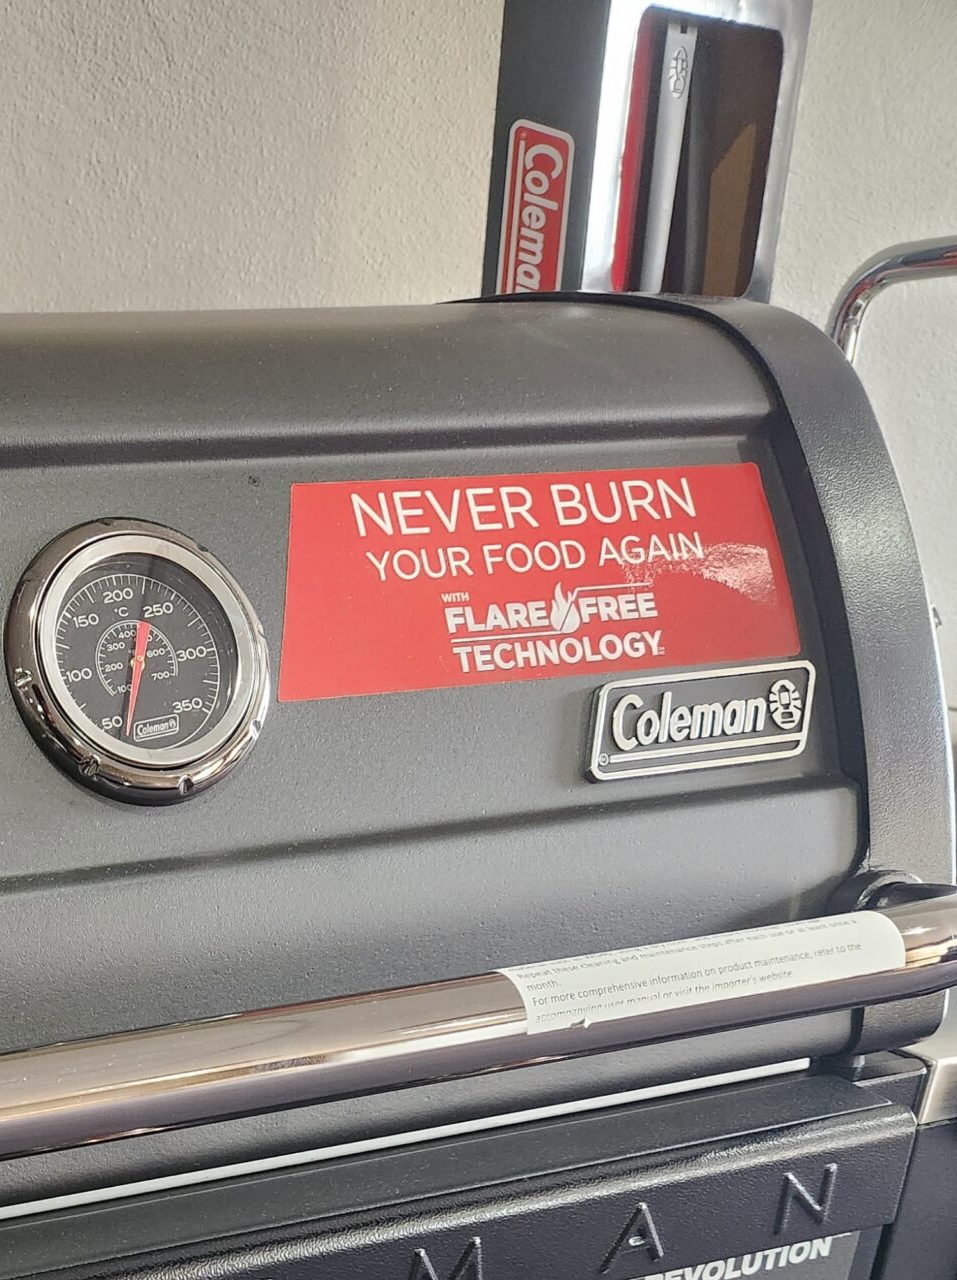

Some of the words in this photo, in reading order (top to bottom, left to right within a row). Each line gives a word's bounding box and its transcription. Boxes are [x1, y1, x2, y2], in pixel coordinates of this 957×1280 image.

[514, 143, 564, 293] Colema
[351, 486, 539, 537] NEVER
[551, 478, 697, 527] BURN
[365, 544, 475, 583] YOUR
[484, 539, 586, 575] FOOD
[599, 531, 704, 567] AGAIN
[103, 587, 133, 604] 200
[441, 591, 469, 603] WITH
[142, 602, 174, 618] 250
[443, 600, 549, 634] FLARE
[581, 592, 657, 624] FREE
[72, 613, 100, 629] 150
[106, 642, 126, 652] 300
[146, 648, 166, 658] 600
[177, 645, 207, 662] 300
[452, 630, 662, 673] TECHNOLOGY
[66, 667, 92, 682] 100
[104, 661, 124, 672] 200
[151, 671, 170, 681] 700
[172, 697, 203, 713] 350
[102, 715, 123, 730] 50
[137, 721, 169, 736] Coleman
[611, 689, 766, 753] Coleman
[532, 996, 548, 1007] For
[550, 991, 575, 1003] more
[577, 976, 648, 999] comprehensive
[649, 969, 703, 986] information
[704, 968, 717, 976] on
[718, 960, 753, 975] product
[754, 950, 813, 968] maintenance,
[836, 944, 847, 953] to
[527, 979, 561, 992] month.
[662, 991, 674, 999] or
[674, 986, 692, 997] visit
[695, 983, 710, 993] the
